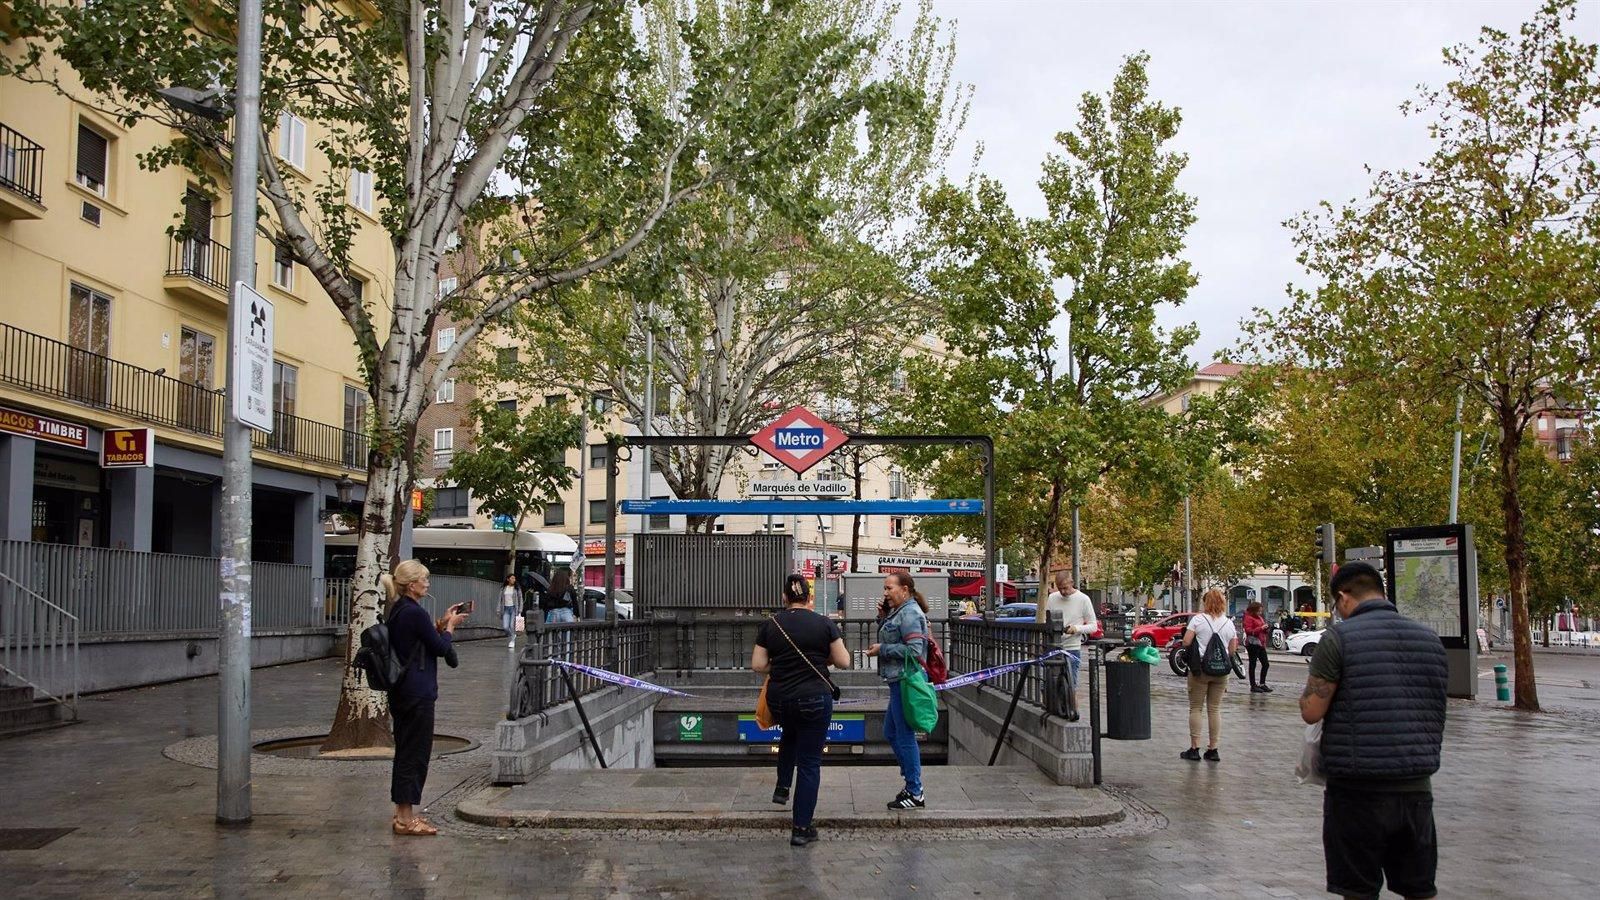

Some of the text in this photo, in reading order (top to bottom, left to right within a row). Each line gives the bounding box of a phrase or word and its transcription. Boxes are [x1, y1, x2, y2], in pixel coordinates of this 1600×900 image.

[38, 419, 83, 440] TIMBRE
[778, 431, 820, 446] Metro
[107, 453, 144, 462] TABACOS
[753, 483, 847, 494] Marqués de Vadillo
[924, 559, 952, 567] MARQUES
